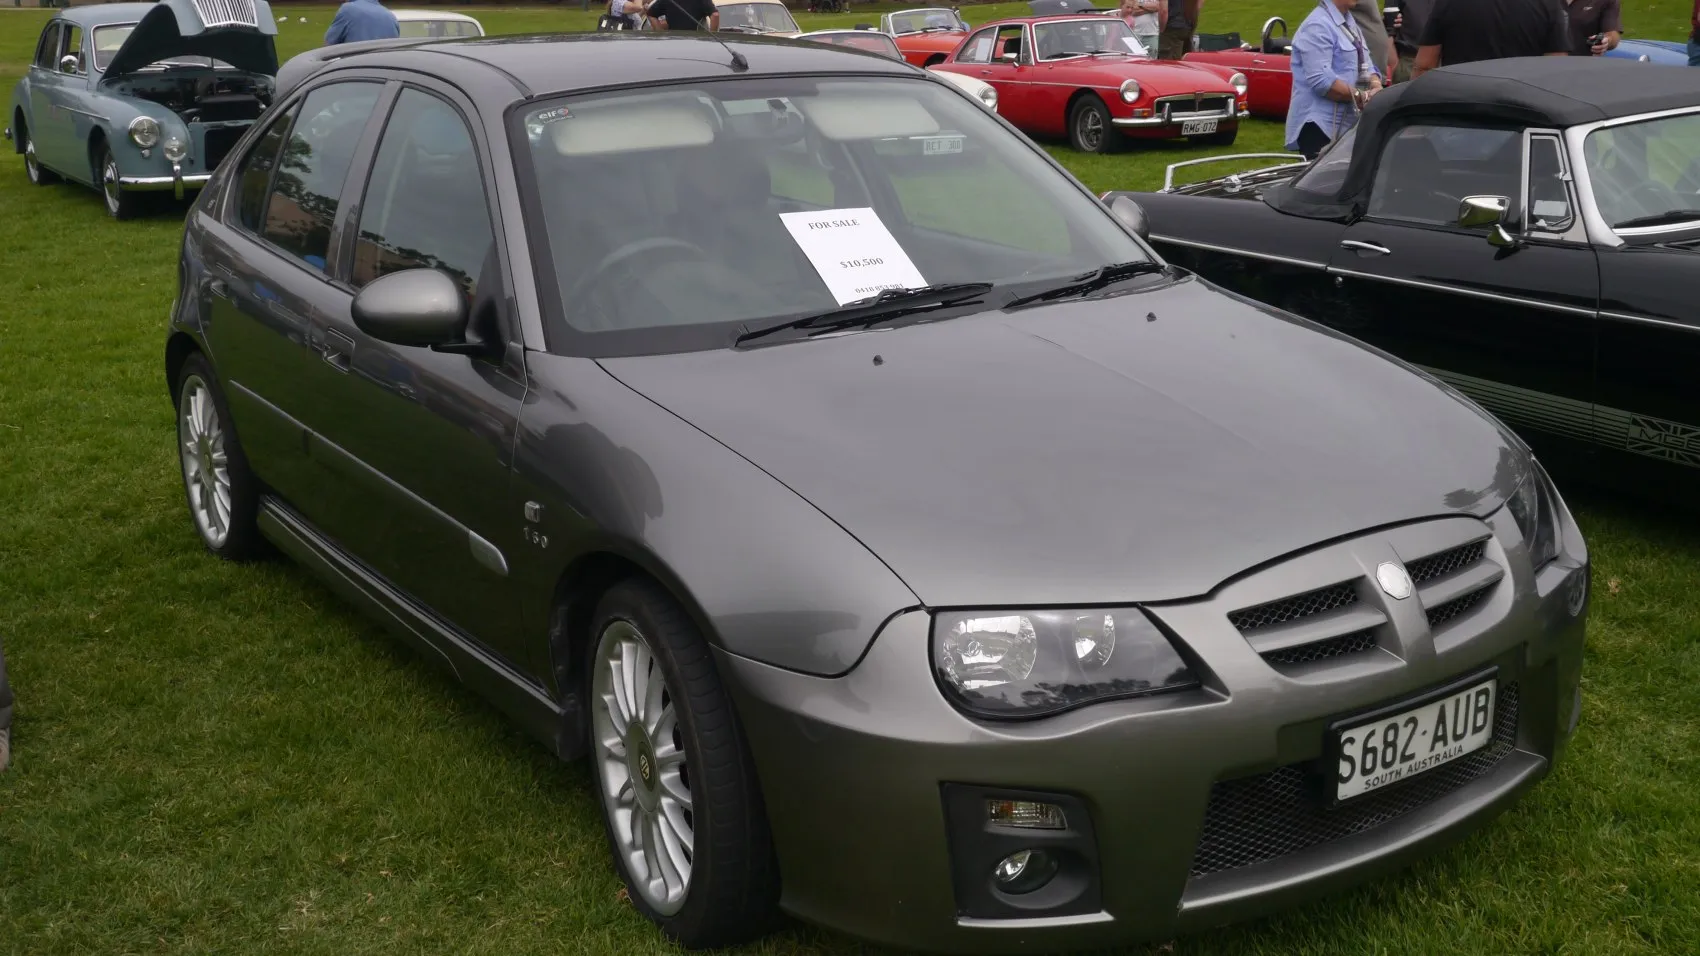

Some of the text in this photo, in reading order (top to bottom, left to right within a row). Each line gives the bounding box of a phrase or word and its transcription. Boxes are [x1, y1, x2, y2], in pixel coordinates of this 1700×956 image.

[808, 218, 860, 230] FOR SALE
[840, 257, 884, 269] $10,500
[1364, 744, 1463, 790] SOUTH AUSTRALIA
